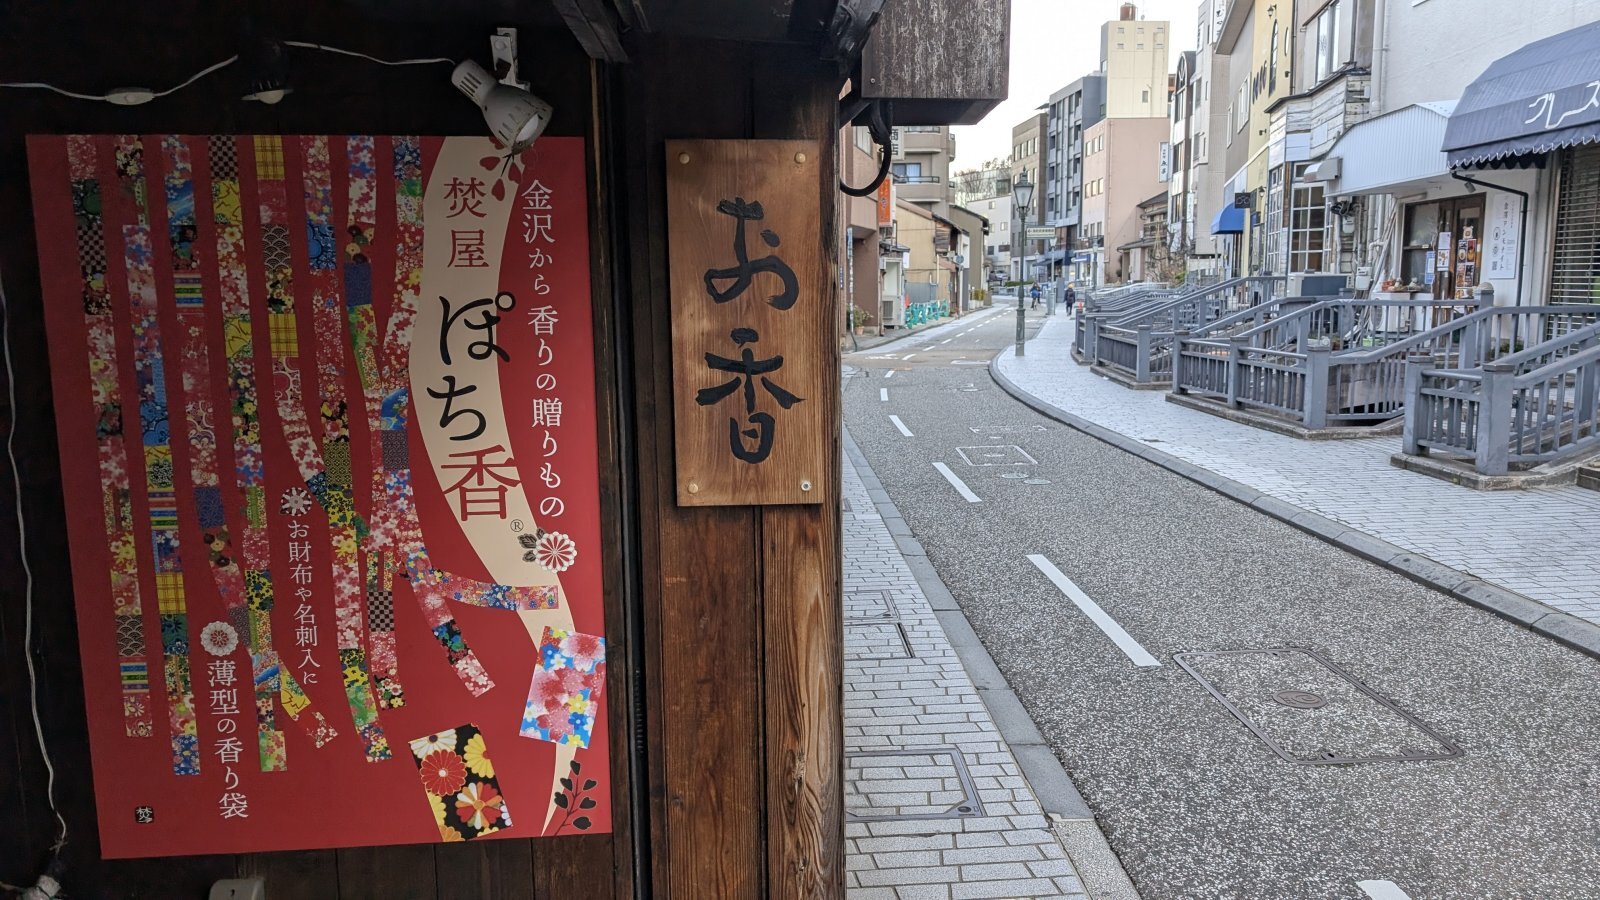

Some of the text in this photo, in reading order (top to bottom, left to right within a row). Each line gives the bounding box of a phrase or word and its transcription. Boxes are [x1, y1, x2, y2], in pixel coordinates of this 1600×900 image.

[521, 179, 565, 518] 金沢から香りの贈りもの
[695, 197, 806, 464] お香
[288, 520, 320, 686] お財布や名刺入に
[206, 659, 249, 819] 薄型の香り袋
